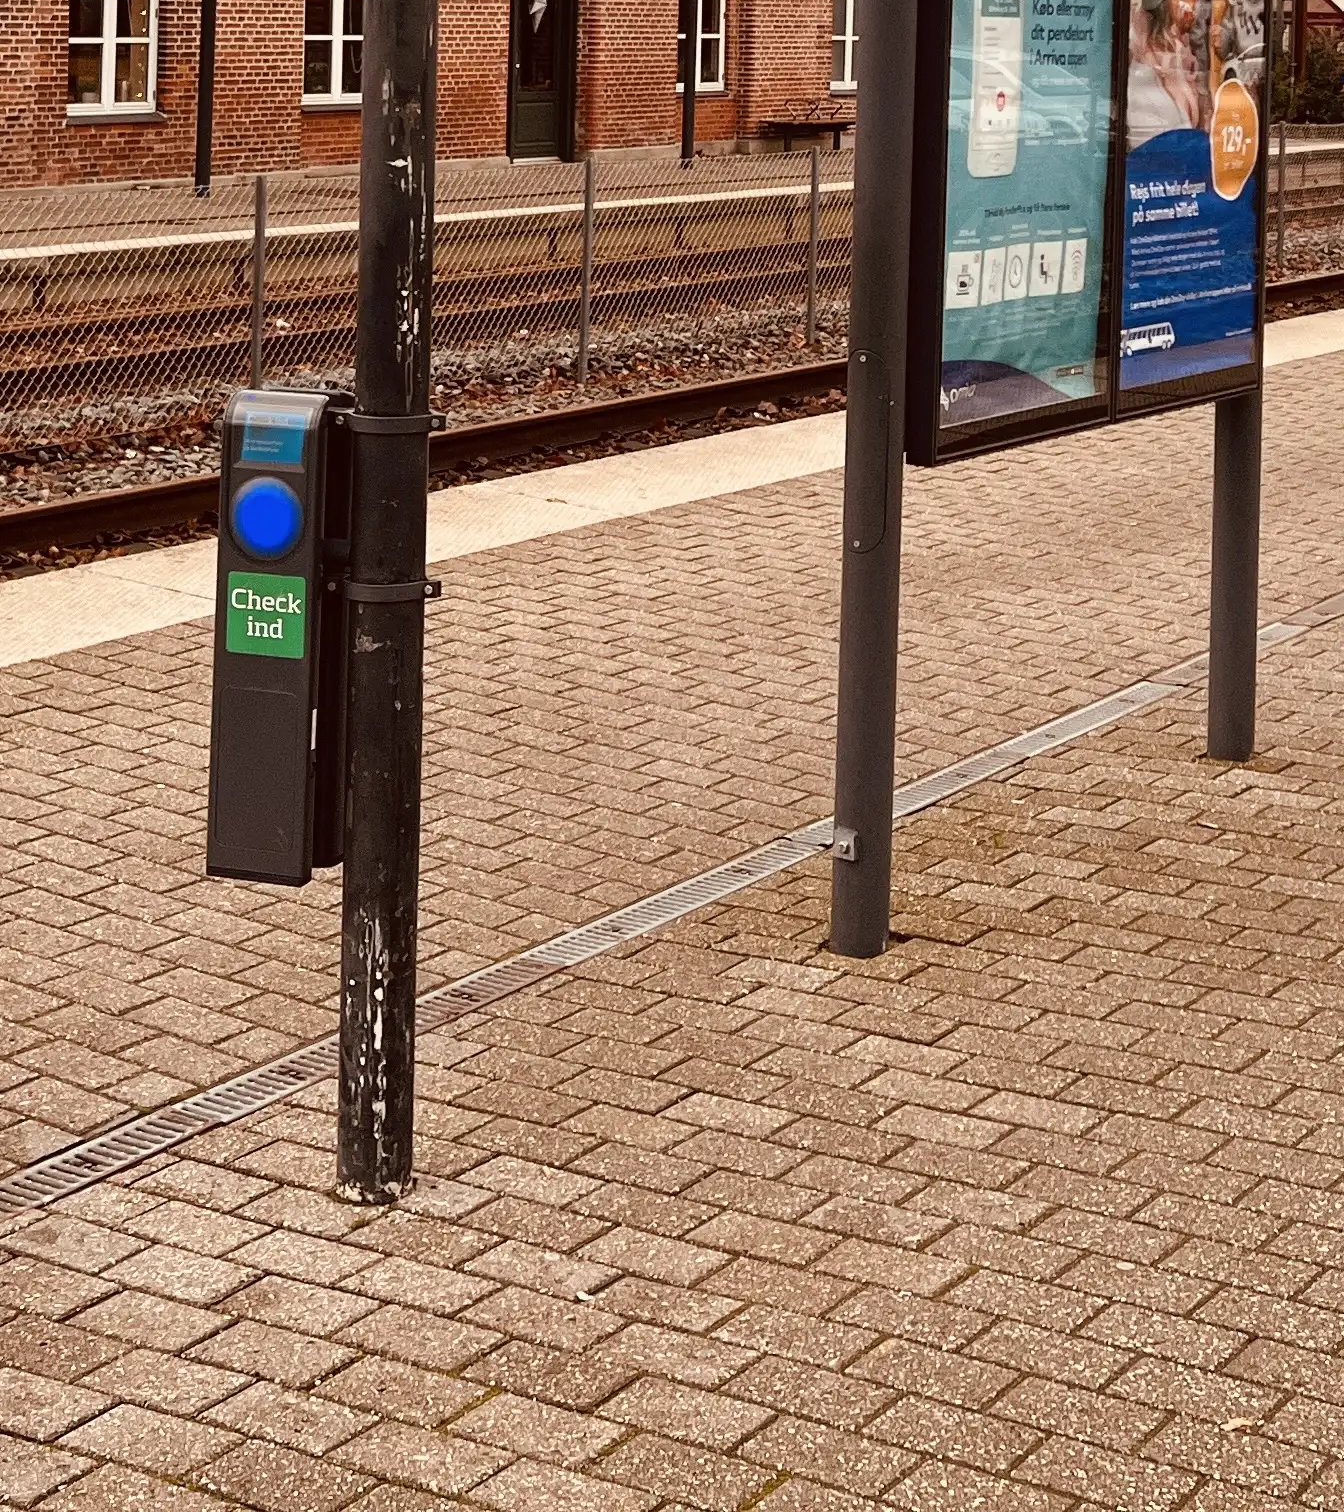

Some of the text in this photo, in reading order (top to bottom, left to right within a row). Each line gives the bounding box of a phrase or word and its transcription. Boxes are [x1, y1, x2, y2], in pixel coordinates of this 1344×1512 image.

[1034, 49, 1066, 66] Arriva
[1221, 125, 1252, 157] 129,-
[1129, 182, 1150, 203] Rejs
[1132, 204, 1145, 227] på
[231, 587, 302, 614] Check
[246, 615, 284, 640] ind
